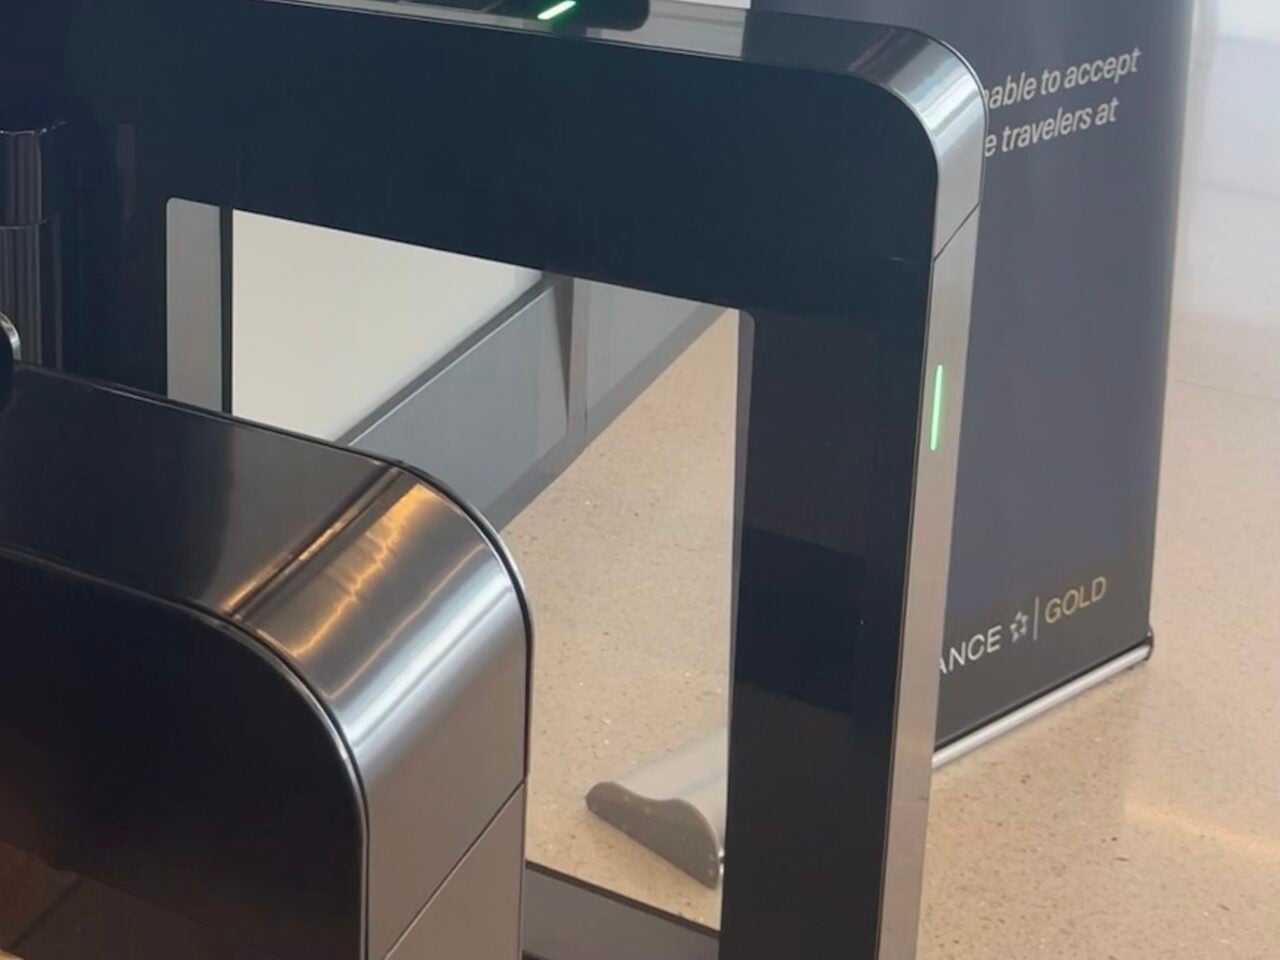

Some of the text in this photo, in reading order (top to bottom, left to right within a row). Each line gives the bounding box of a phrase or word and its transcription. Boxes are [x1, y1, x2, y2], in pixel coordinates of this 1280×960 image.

[1040, 68, 1061, 96] to
[1063, 47, 1141, 85] accept
[1001, 106, 1093, 153] travelers
[1094, 96, 1120, 126] at
[1044, 576, 1107, 624] GOLD
